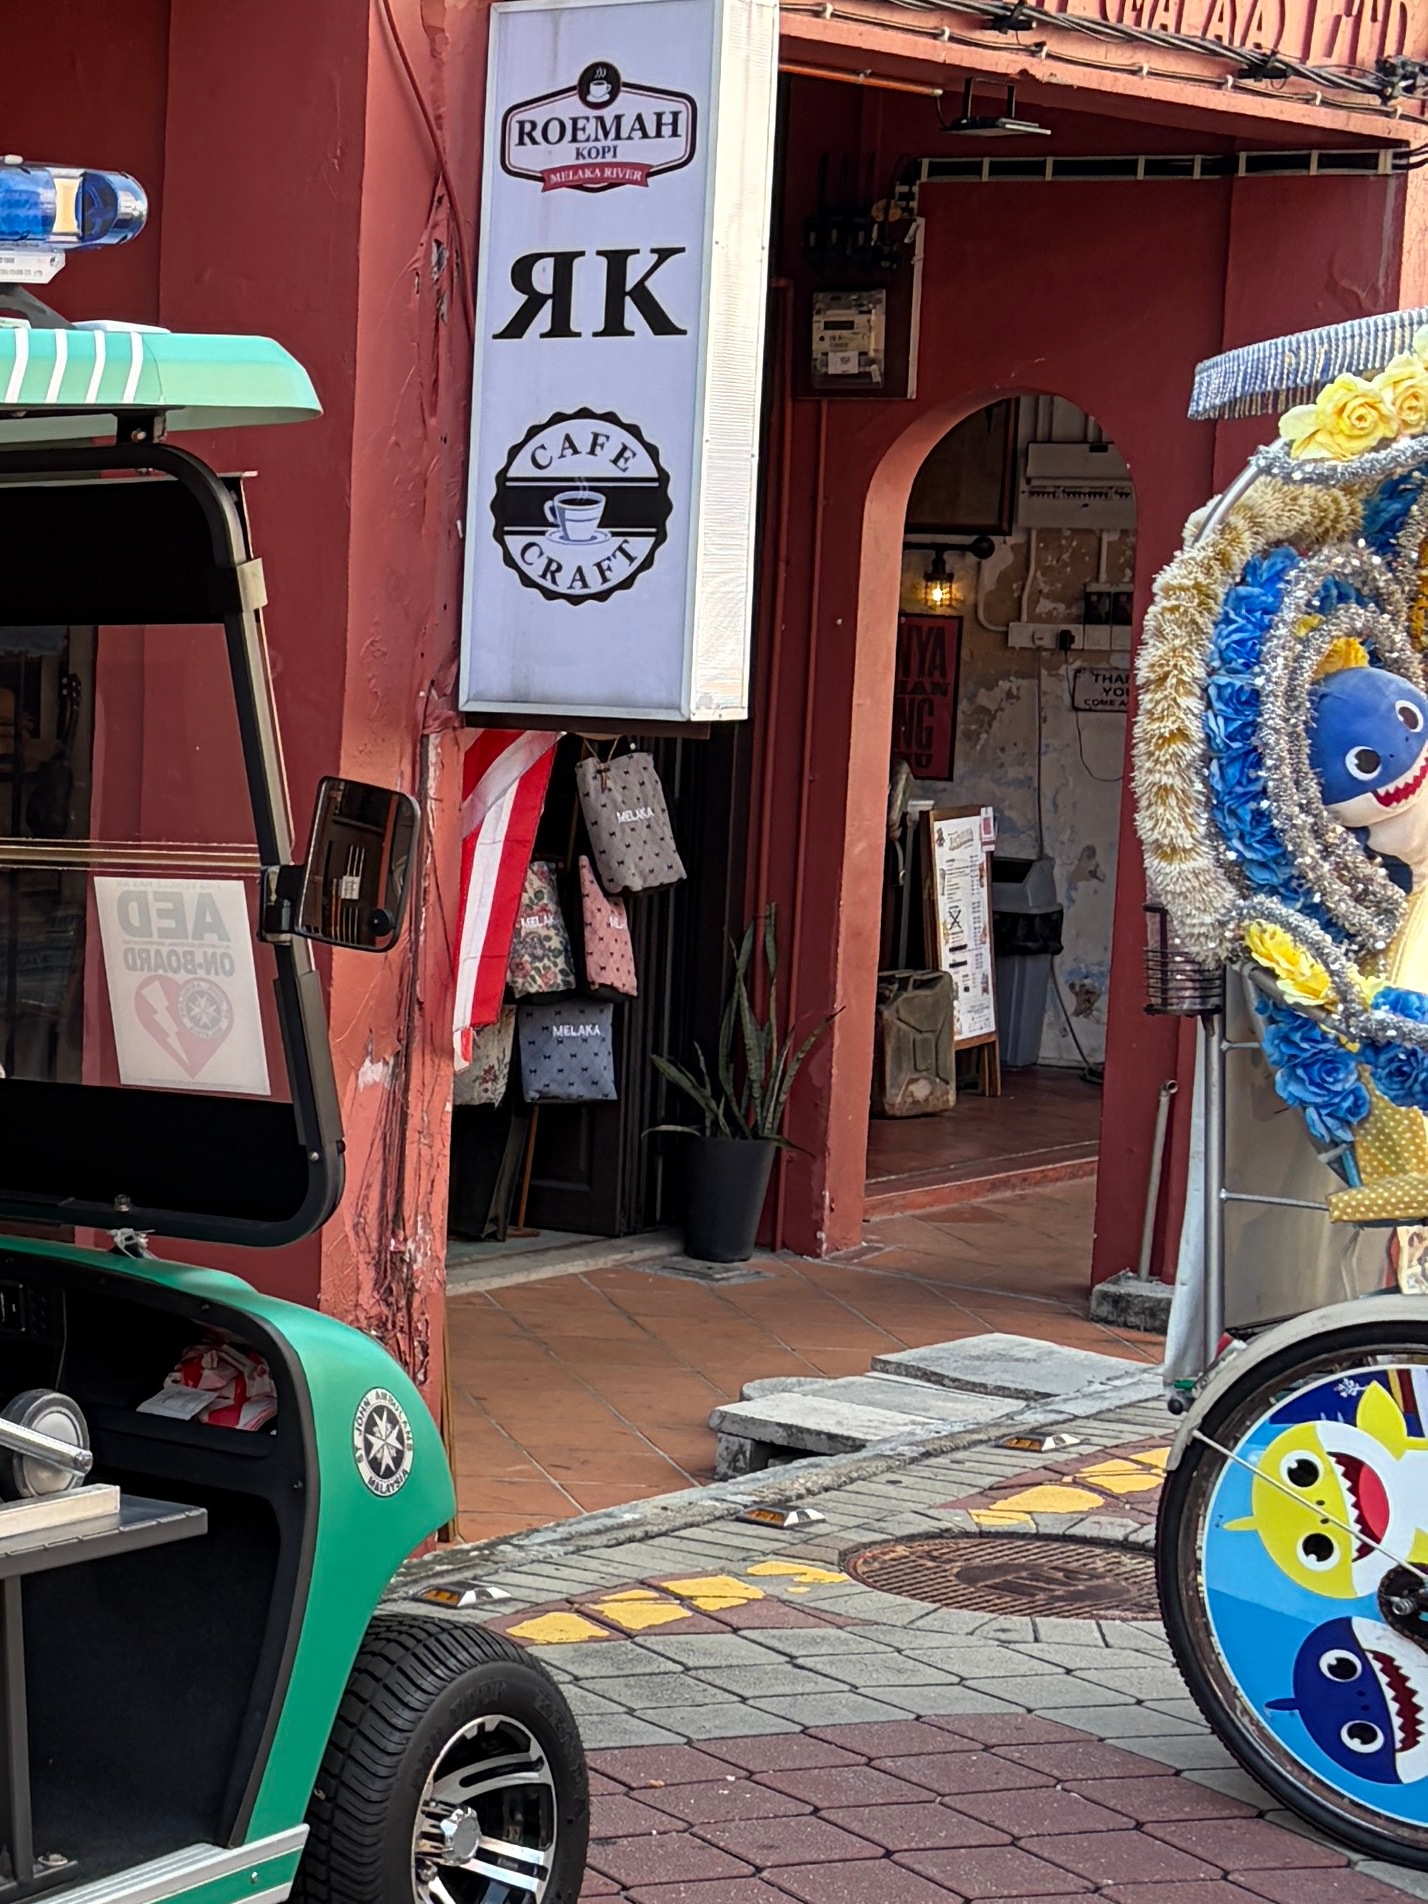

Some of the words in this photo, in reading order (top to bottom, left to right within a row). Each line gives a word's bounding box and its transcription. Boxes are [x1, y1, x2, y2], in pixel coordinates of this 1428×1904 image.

[514, 110, 683, 147] ROEMAH
[574, 145, 619, 161] KOPI
[549, 168, 602, 185] MELAKA
[603, 166, 643, 182] RIVER
[529, 429, 638, 474] CAFE
[518, 537, 639, 594] CRAFT
[616, 806, 655, 824] MELAKA
[552, 1024, 601, 1037] MELAKA
